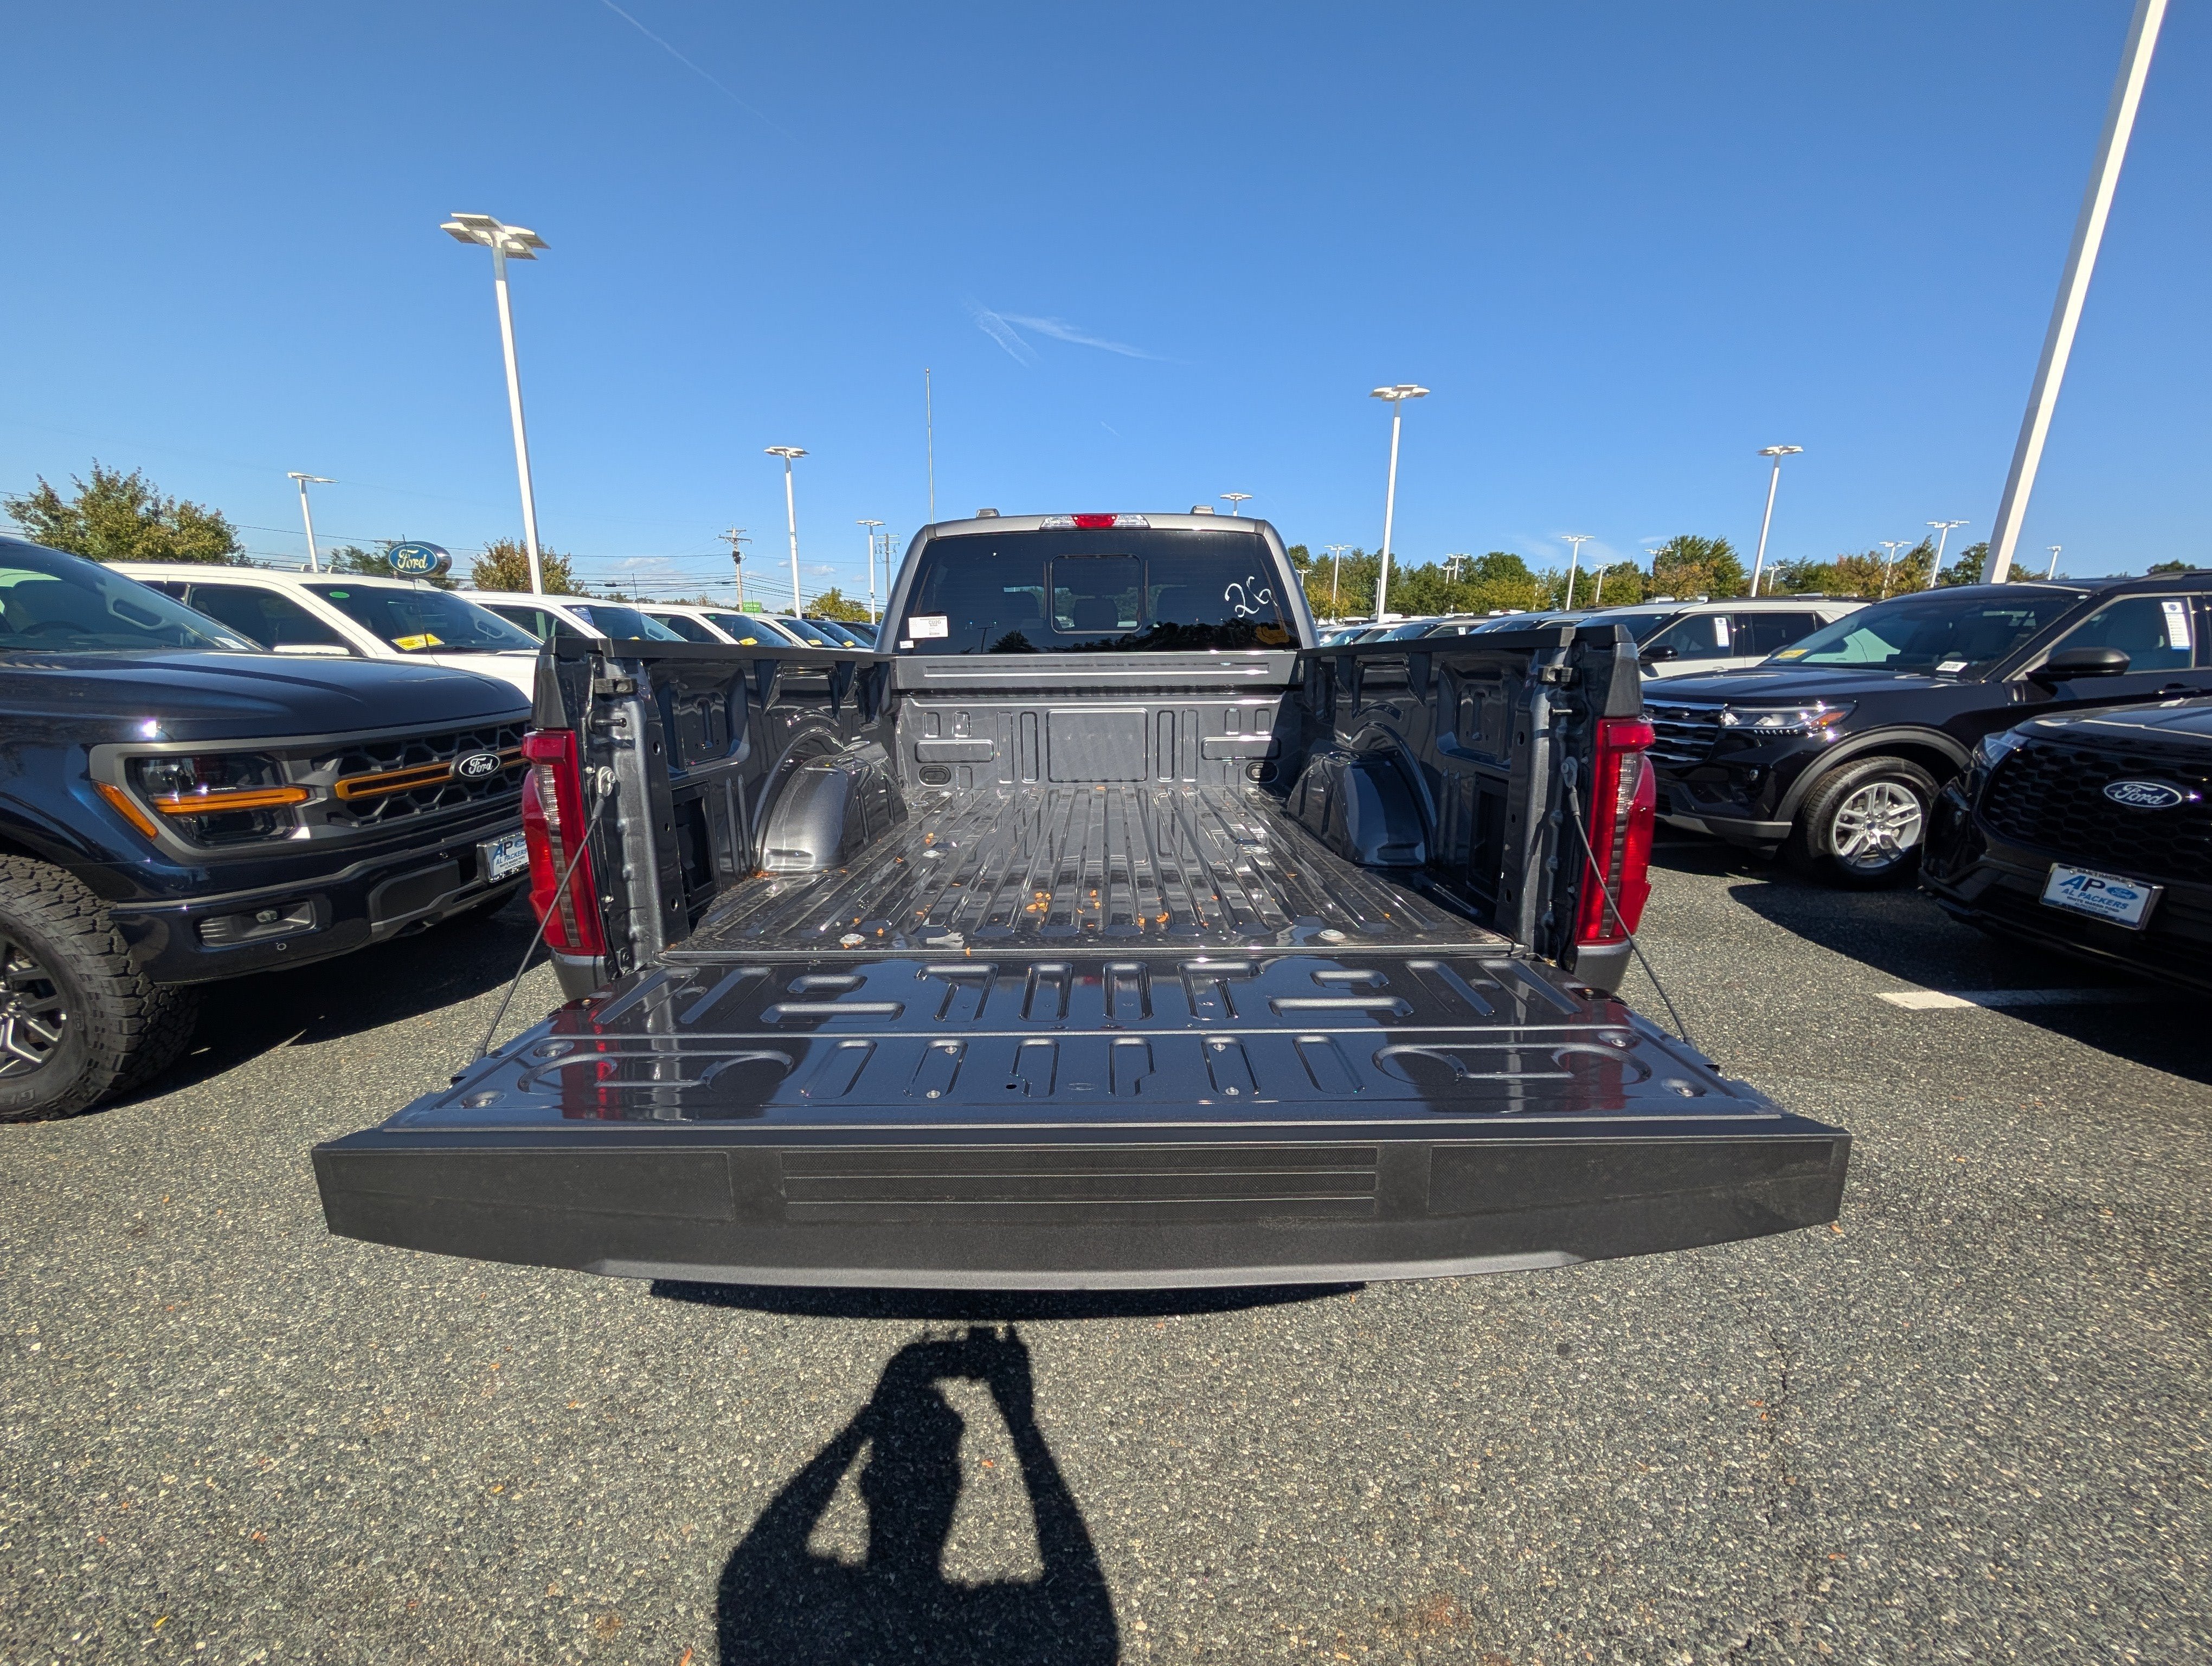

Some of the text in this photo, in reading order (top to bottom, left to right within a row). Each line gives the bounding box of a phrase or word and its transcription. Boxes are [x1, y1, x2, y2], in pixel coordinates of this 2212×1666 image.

[397, 549, 428, 569] Ford
[1224, 575, 1278, 618] 26
[468, 757, 493, 774] Ford
[2114, 784, 2169, 804] Ford
[492, 841, 513, 861] AP
[504, 848, 528, 861] PACKERS
[2059, 875, 2106, 892] AP
[2078, 892, 2129, 909] PACKERS
